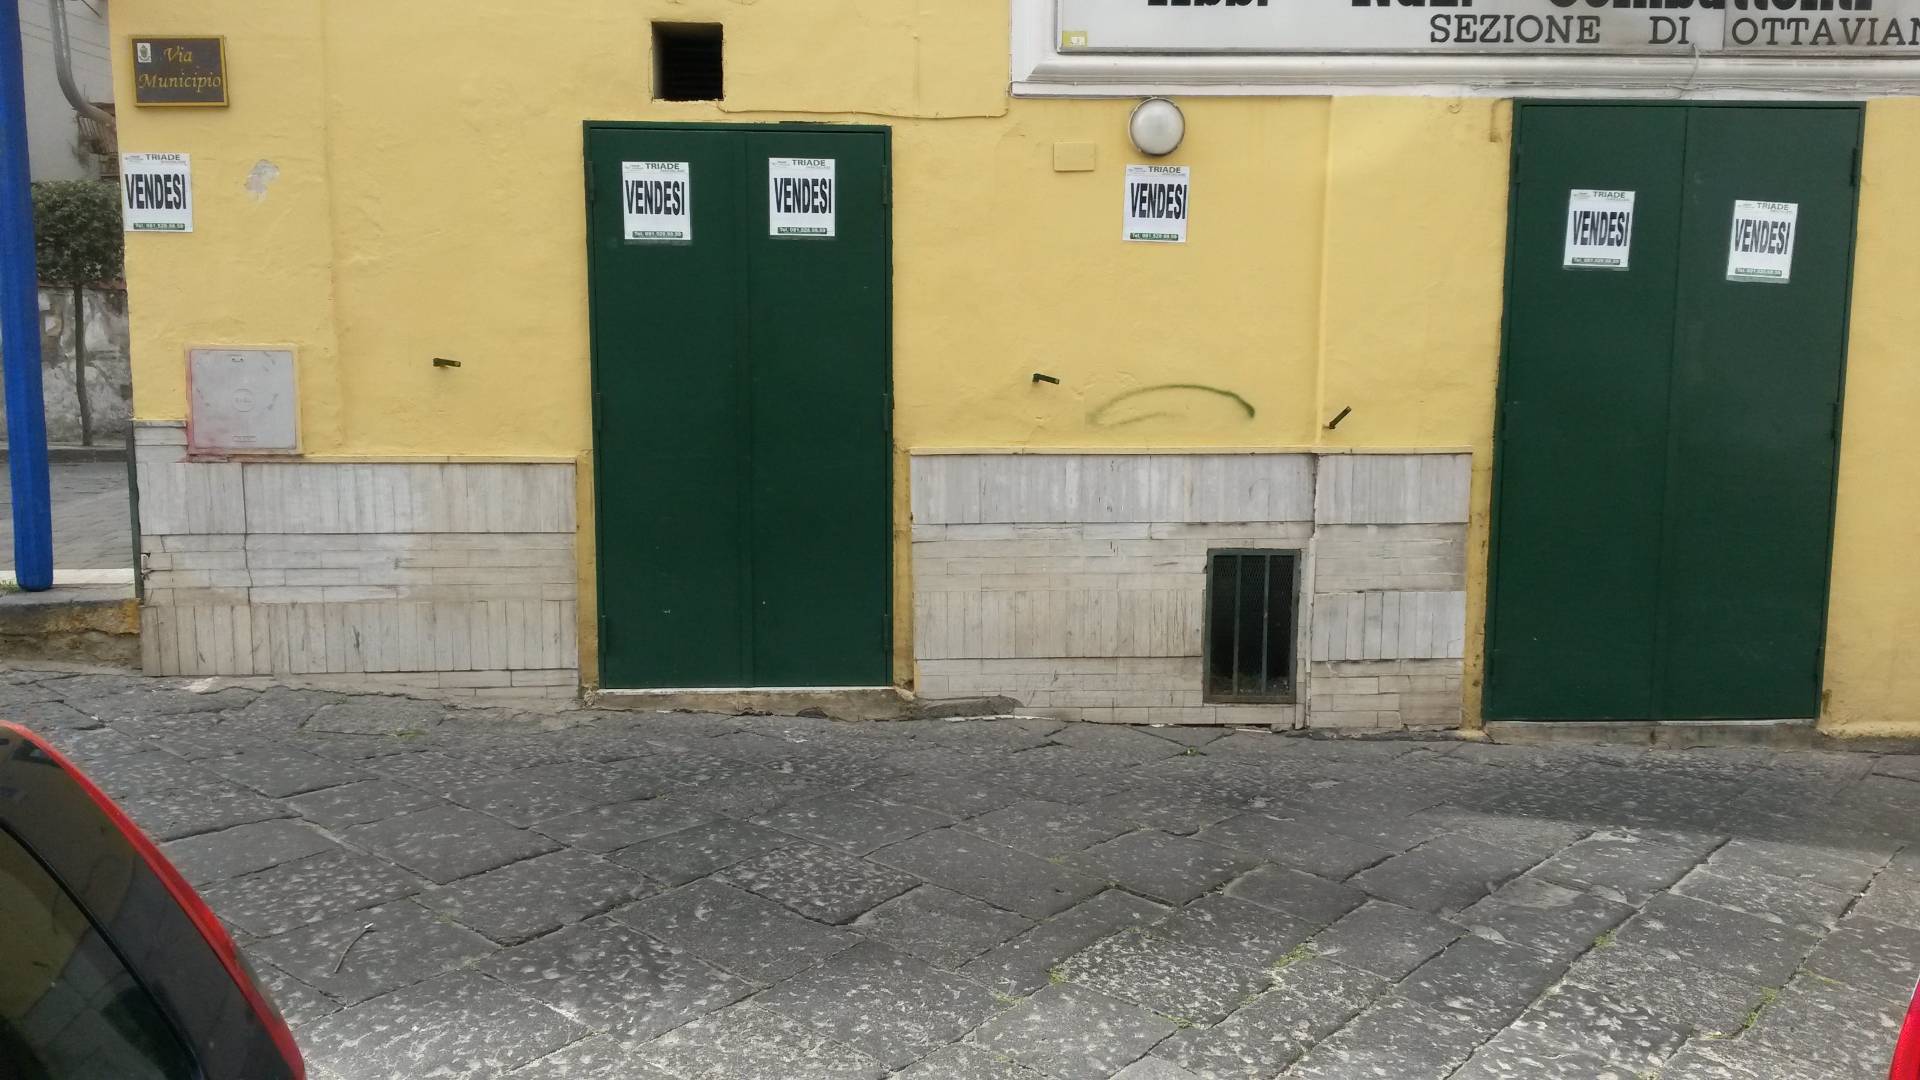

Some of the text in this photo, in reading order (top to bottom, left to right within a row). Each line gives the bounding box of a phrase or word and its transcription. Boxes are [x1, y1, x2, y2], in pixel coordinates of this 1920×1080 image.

[1430, 13, 1601, 43] SEZIONE
[1648, 15, 1691, 45] DI
[163, 45, 193, 62] Via
[138, 71, 221, 93] Municipio
[645, 162, 680, 170] TRIADE
[1148, 166, 1182, 174] TRIADE
[124, 173, 187, 210] VENDESI
[625, 180, 685, 216] VENDESI
[773, 177, 832, 214] VENDESI
[1130, 182, 1188, 220] VENDESI
[1593, 191, 1626, 199] TRIADE
[1756, 202, 1790, 211] TRIADE
[1573, 210, 1630, 247] VENDESI
[1735, 218, 1791, 255] VENDESI
